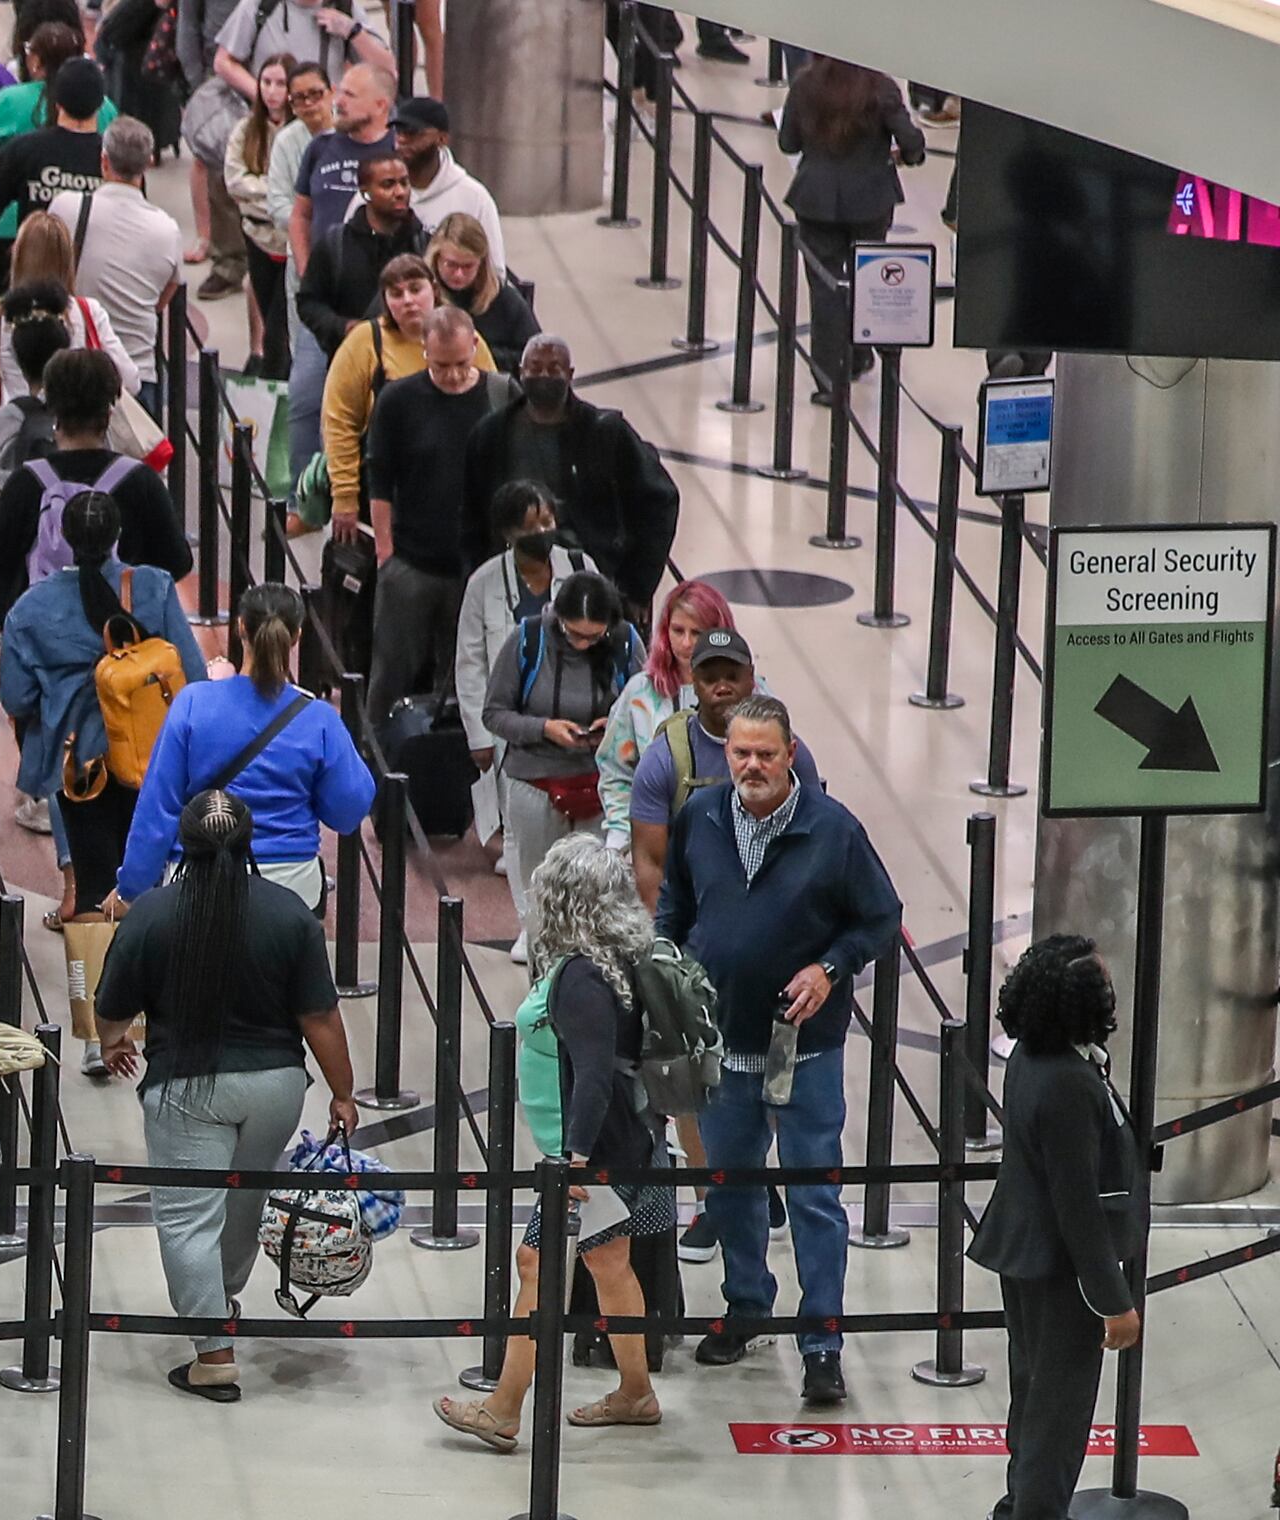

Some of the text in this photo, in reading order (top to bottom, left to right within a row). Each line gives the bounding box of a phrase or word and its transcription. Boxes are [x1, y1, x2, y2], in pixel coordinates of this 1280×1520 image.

[1070, 546, 1257, 577] General Security
[1106, 585, 1219, 616] Screening
[1066, 629, 1255, 646] Access to All Gates and Flights
[851, 1428, 914, 1439] NO
